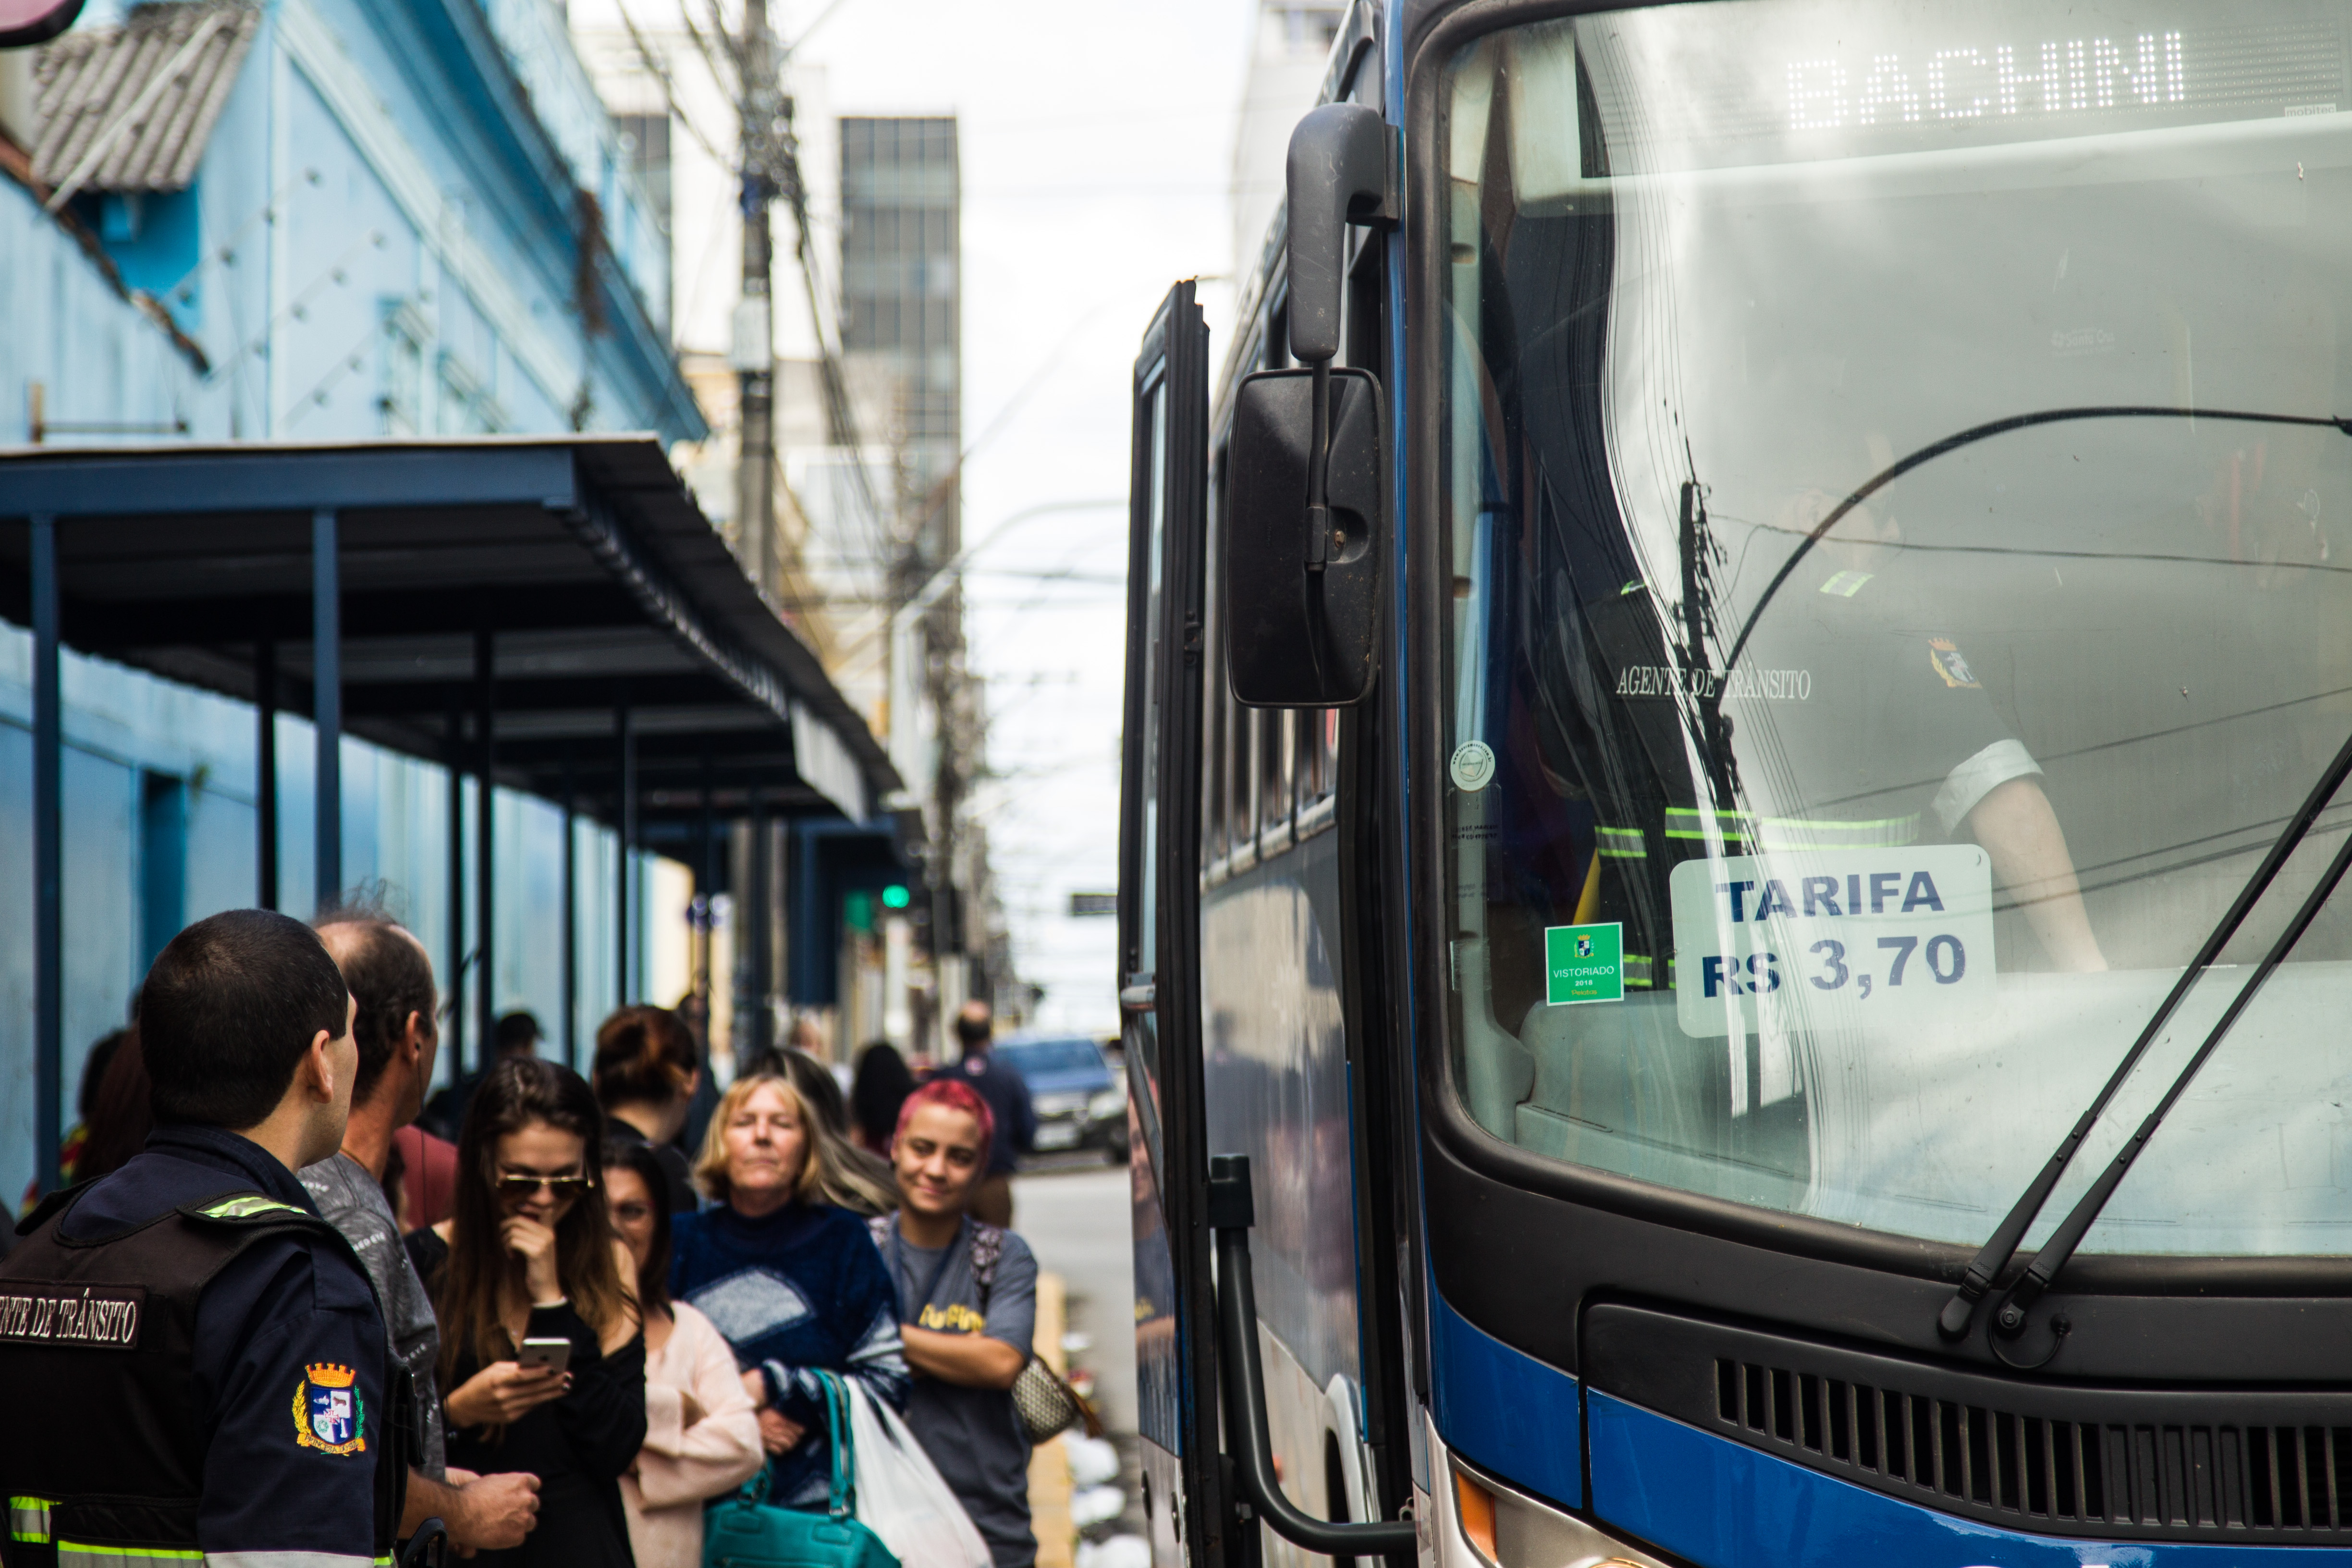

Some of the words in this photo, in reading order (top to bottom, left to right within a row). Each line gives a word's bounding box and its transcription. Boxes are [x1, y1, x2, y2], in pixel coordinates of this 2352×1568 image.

[1788, 30, 2183, 130] BACHINI
[2287, 106, 2334, 117] mobitec
[1616, 666, 1687, 696] AGENTE
[1693, 668, 1716, 698] DE
[1724, 662, 1811, 700] TRÂNSITO
[1715, 870, 1945, 923] TARIFA
[1553, 966, 1615, 978] VISTORIADO
[1809, 934, 1966, 1000] 3,70
[29, 1298, 57, 1338] DE
[56, 1287, 136, 1344] TRÂNSITO
